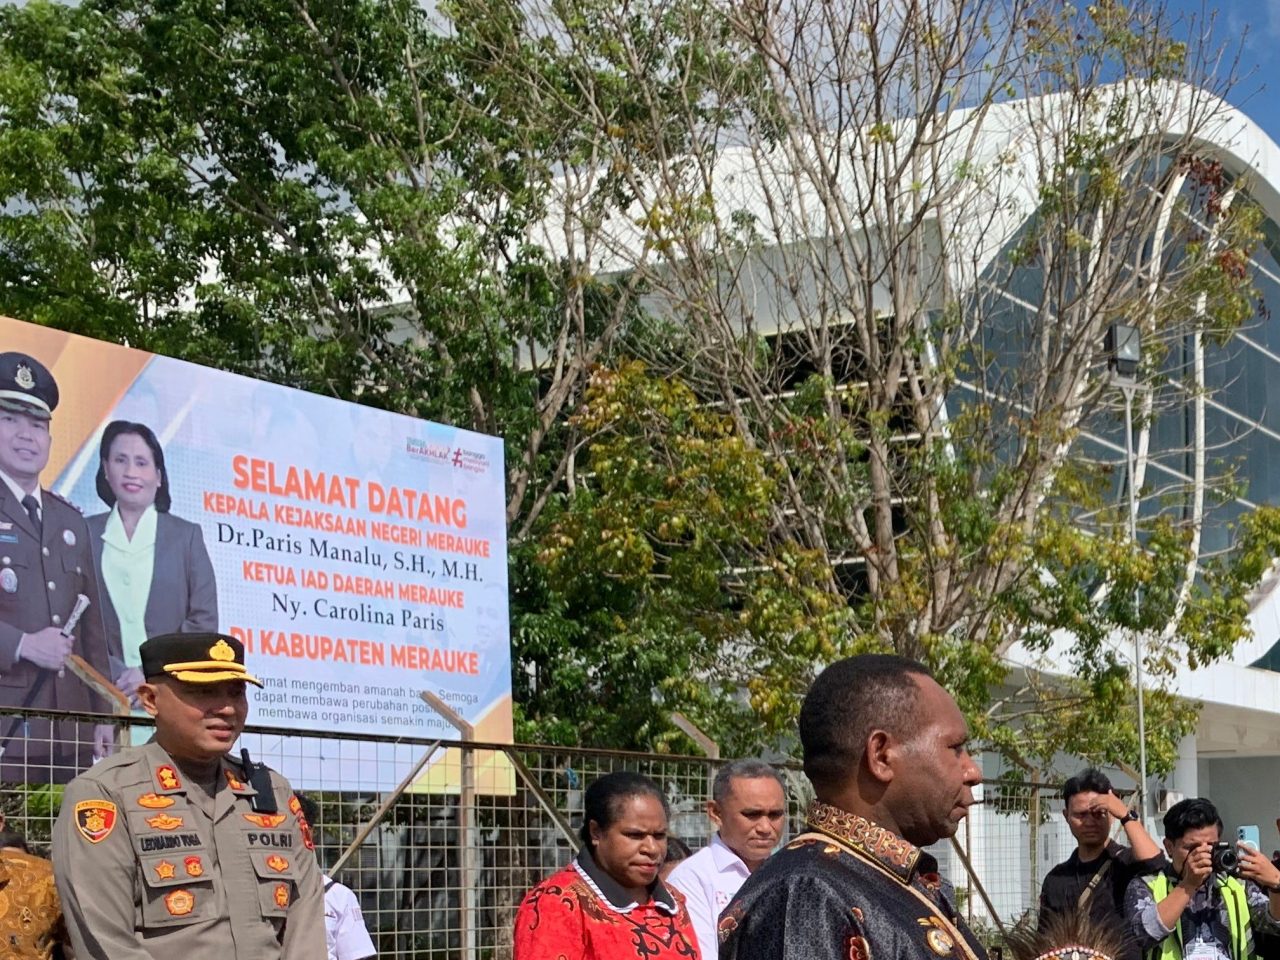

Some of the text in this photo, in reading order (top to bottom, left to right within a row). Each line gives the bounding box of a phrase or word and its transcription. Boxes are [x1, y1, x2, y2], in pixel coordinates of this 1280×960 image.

[232, 454, 467, 528] SELAMAT DATANG
[203, 491, 490, 558] KEPALA KEJAKSAAN NEGERI MERAUKE
[309, 537, 387, 571] Manalu,
[394, 551, 435, 578] S.H.,
[441, 558, 483, 582] M.H.
[243, 560, 465, 609] KETUA IAD DAERAH MERAUKE
[272, 592, 444, 632] Ny. Carolina Paris
[260, 629, 385, 667] KABUPATEN
[390, 643, 479, 675] MERAUKE
[254, 674, 287, 688] amat
[291, 680, 361, 695] mengemban
[363, 685, 406, 698] amanah
[438, 689, 479, 705] Semoga
[254, 690, 287, 704] dapat
[291, 694, 348, 708] membawa
[352, 698, 408, 711] perubahan
[258, 707, 318, 720] membawa
[321, 711, 378, 725] organisasi
[380, 715, 424, 727] semakin
[247, 833, 293, 848] POLRI
